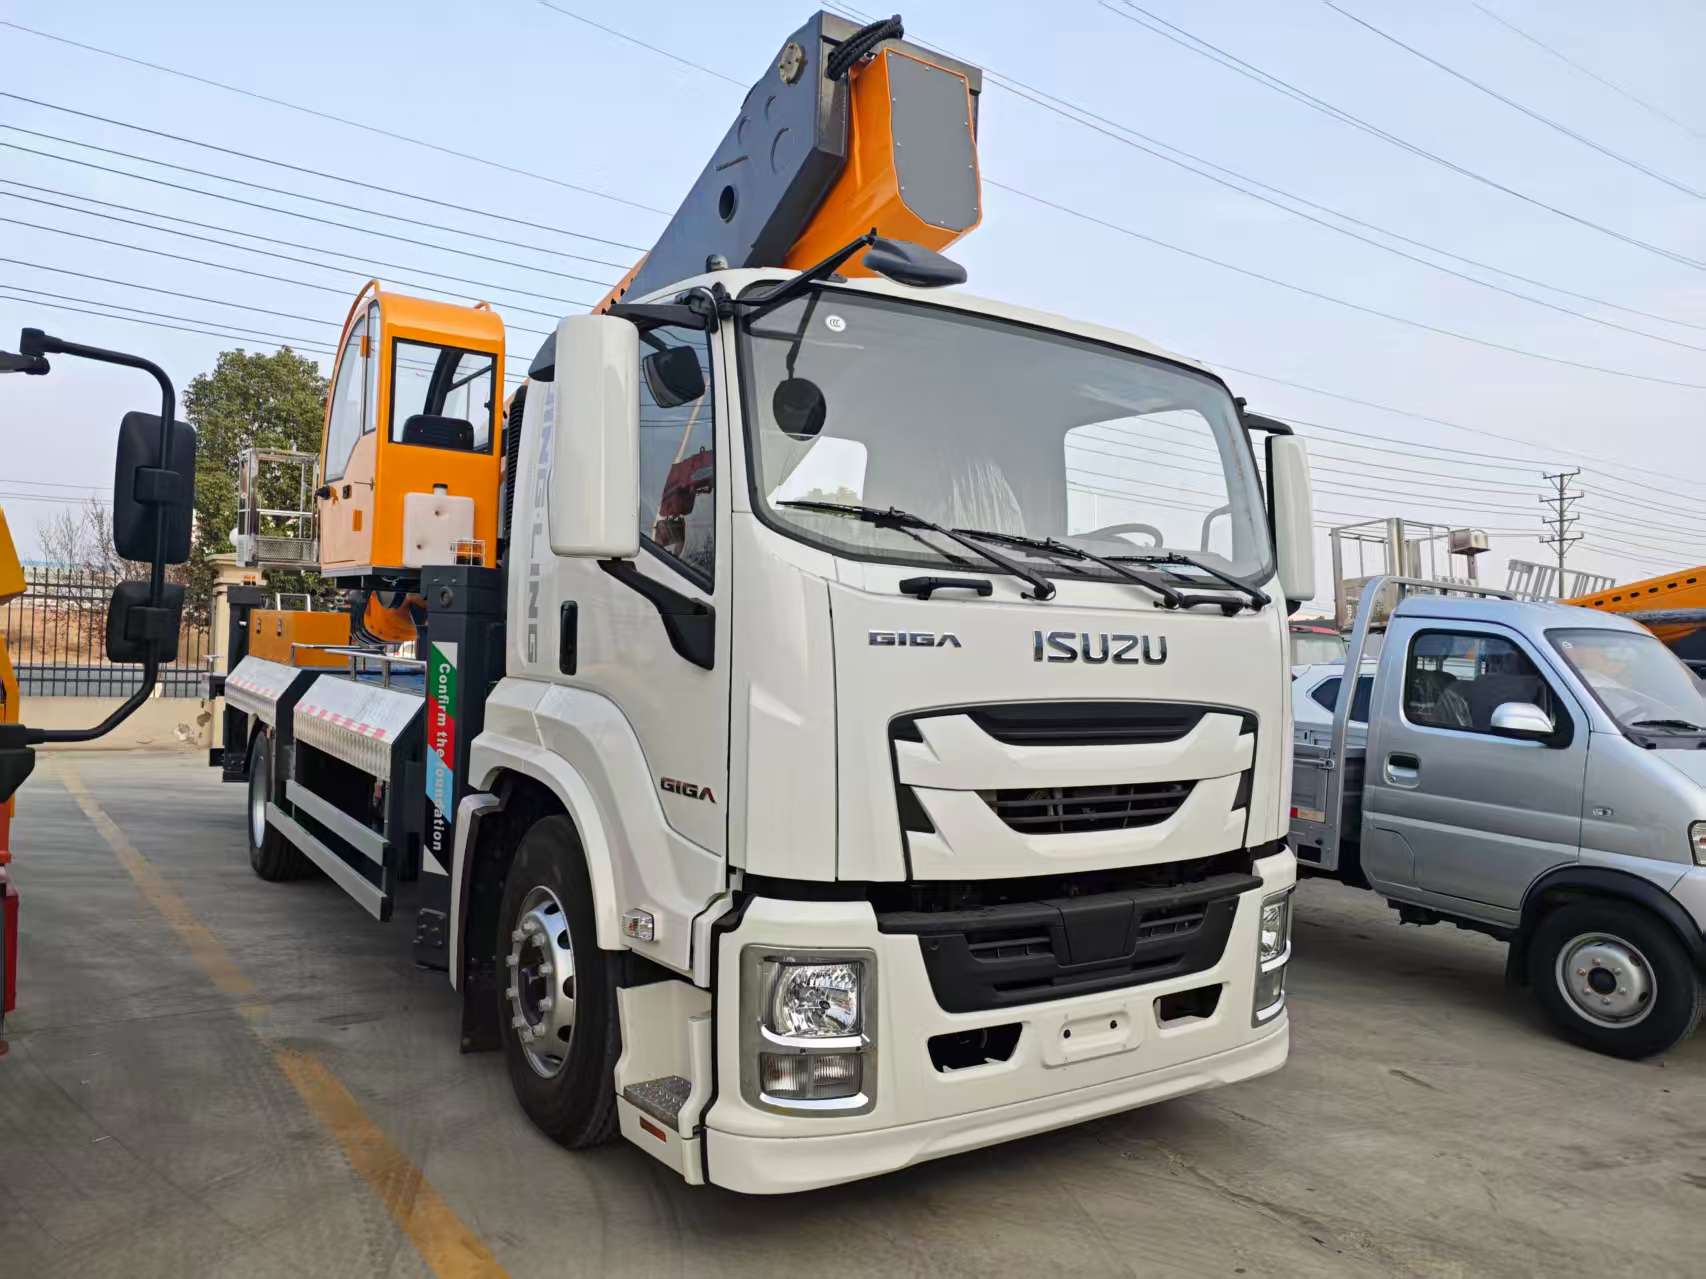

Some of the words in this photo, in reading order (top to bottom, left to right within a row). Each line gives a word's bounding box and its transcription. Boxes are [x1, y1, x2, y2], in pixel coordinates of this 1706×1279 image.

[868, 630, 962, 648] GIGA
[1033, 630, 1168, 666] ISUZU
[438, 663, 451, 727] Confirm
[436, 731, 449, 758] the
[661, 776, 717, 804] GIGA
